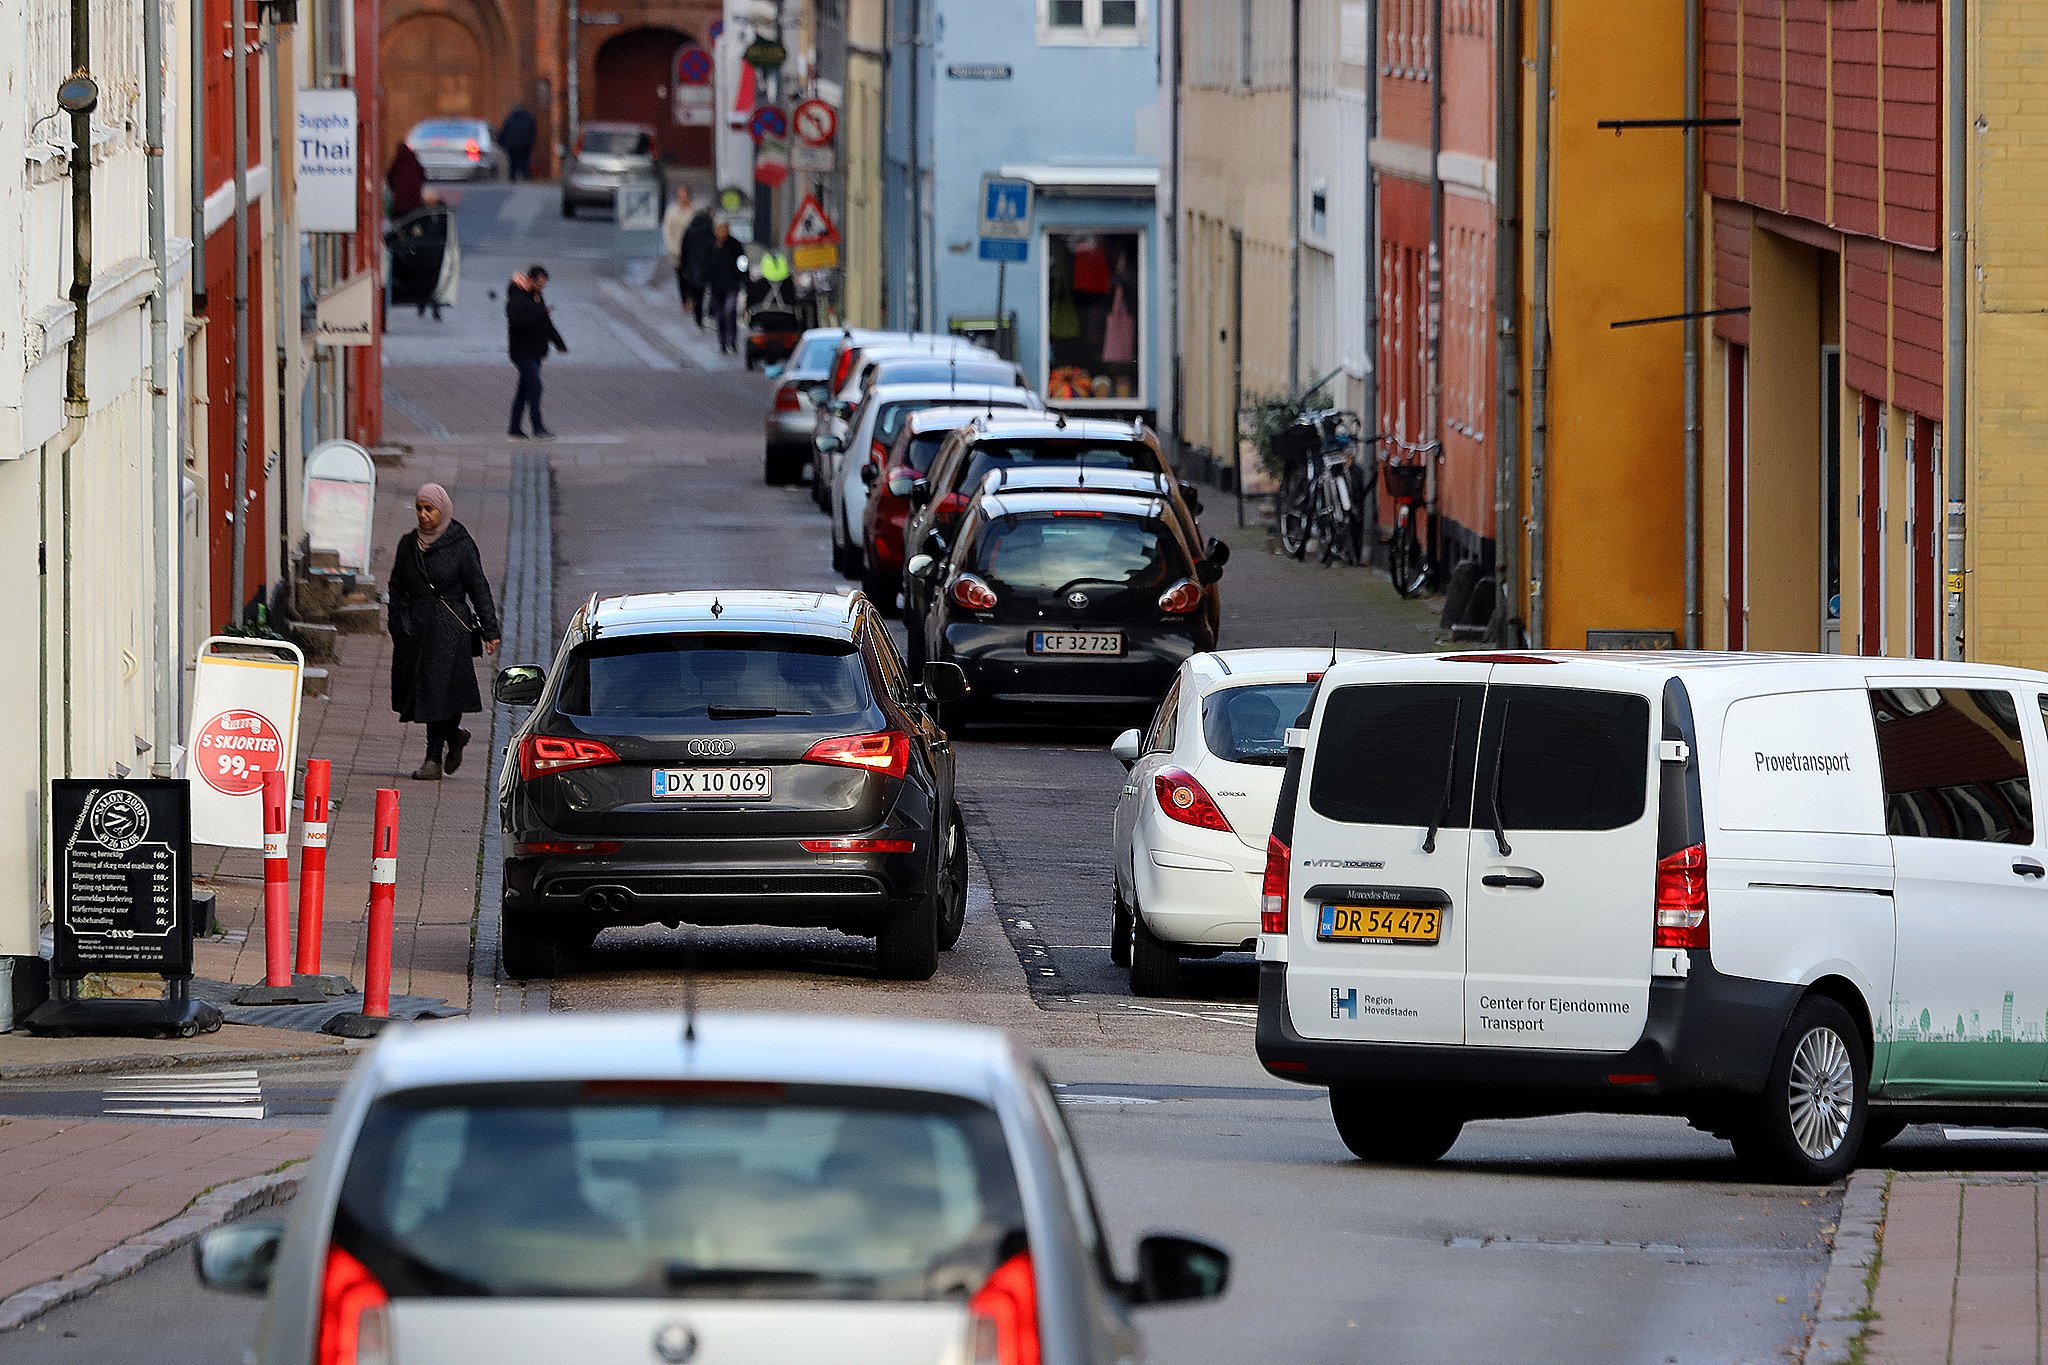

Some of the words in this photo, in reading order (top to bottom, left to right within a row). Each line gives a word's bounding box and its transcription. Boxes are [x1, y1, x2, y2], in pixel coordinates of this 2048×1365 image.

[301, 138, 350, 159] Thai
[1045, 636, 1065, 649] CF
[1069, 637, 1087, 650] 32
[1091, 637, 1118, 650] 723
[202, 733, 212, 748] 5
[213, 734, 276, 752] SKJORTER
[217, 754, 260, 780] 99,-
[668, 773, 695, 792] DX
[702, 773, 724, 792] 10
[729, 772, 766, 792] 069
[95, 793, 124, 815] SALON
[124, 794, 145, 816] 2000
[65, 831, 79, 851] Uden
[1347, 890, 1401, 900] Mercedes-Benz
[1335, 910, 1362, 932] DR
[1367, 911, 1393, 933] 54
[1398, 911, 1436, 934] 473
[1364, 994, 1393, 1005] Region
[1480, 996, 1524, 1010] Center
[1527, 998, 1546, 1010] for
[1550, 999, 1630, 1014] Ejendomme
[1364, 1005, 1418, 1017] Hovedstaden
[1480, 1016, 1544, 1032] Transport
